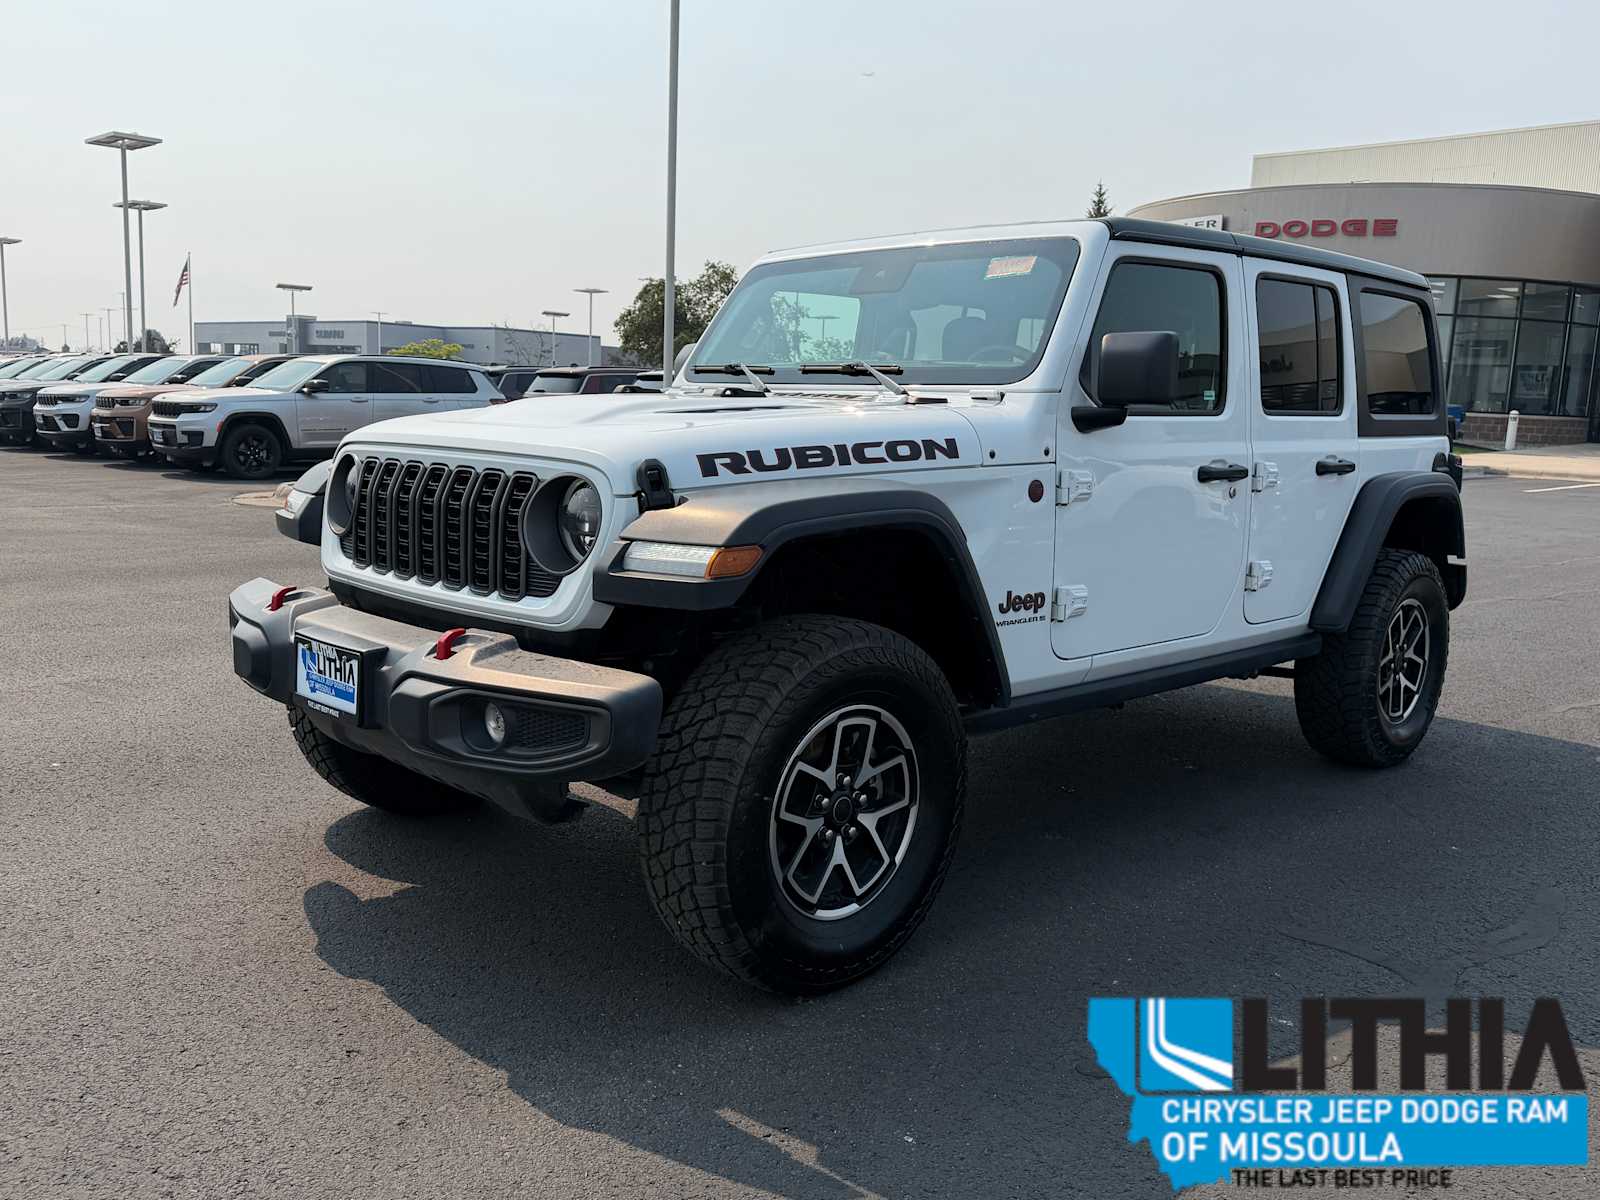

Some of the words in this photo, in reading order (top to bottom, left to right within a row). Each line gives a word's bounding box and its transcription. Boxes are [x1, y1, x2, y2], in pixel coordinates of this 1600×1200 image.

[1255, 219, 1398, 238] DODGE
[696, 438, 959, 477] RUBICON
[998, 590, 1046, 614] Jeep
[317, 650, 355, 686] LITHIA
